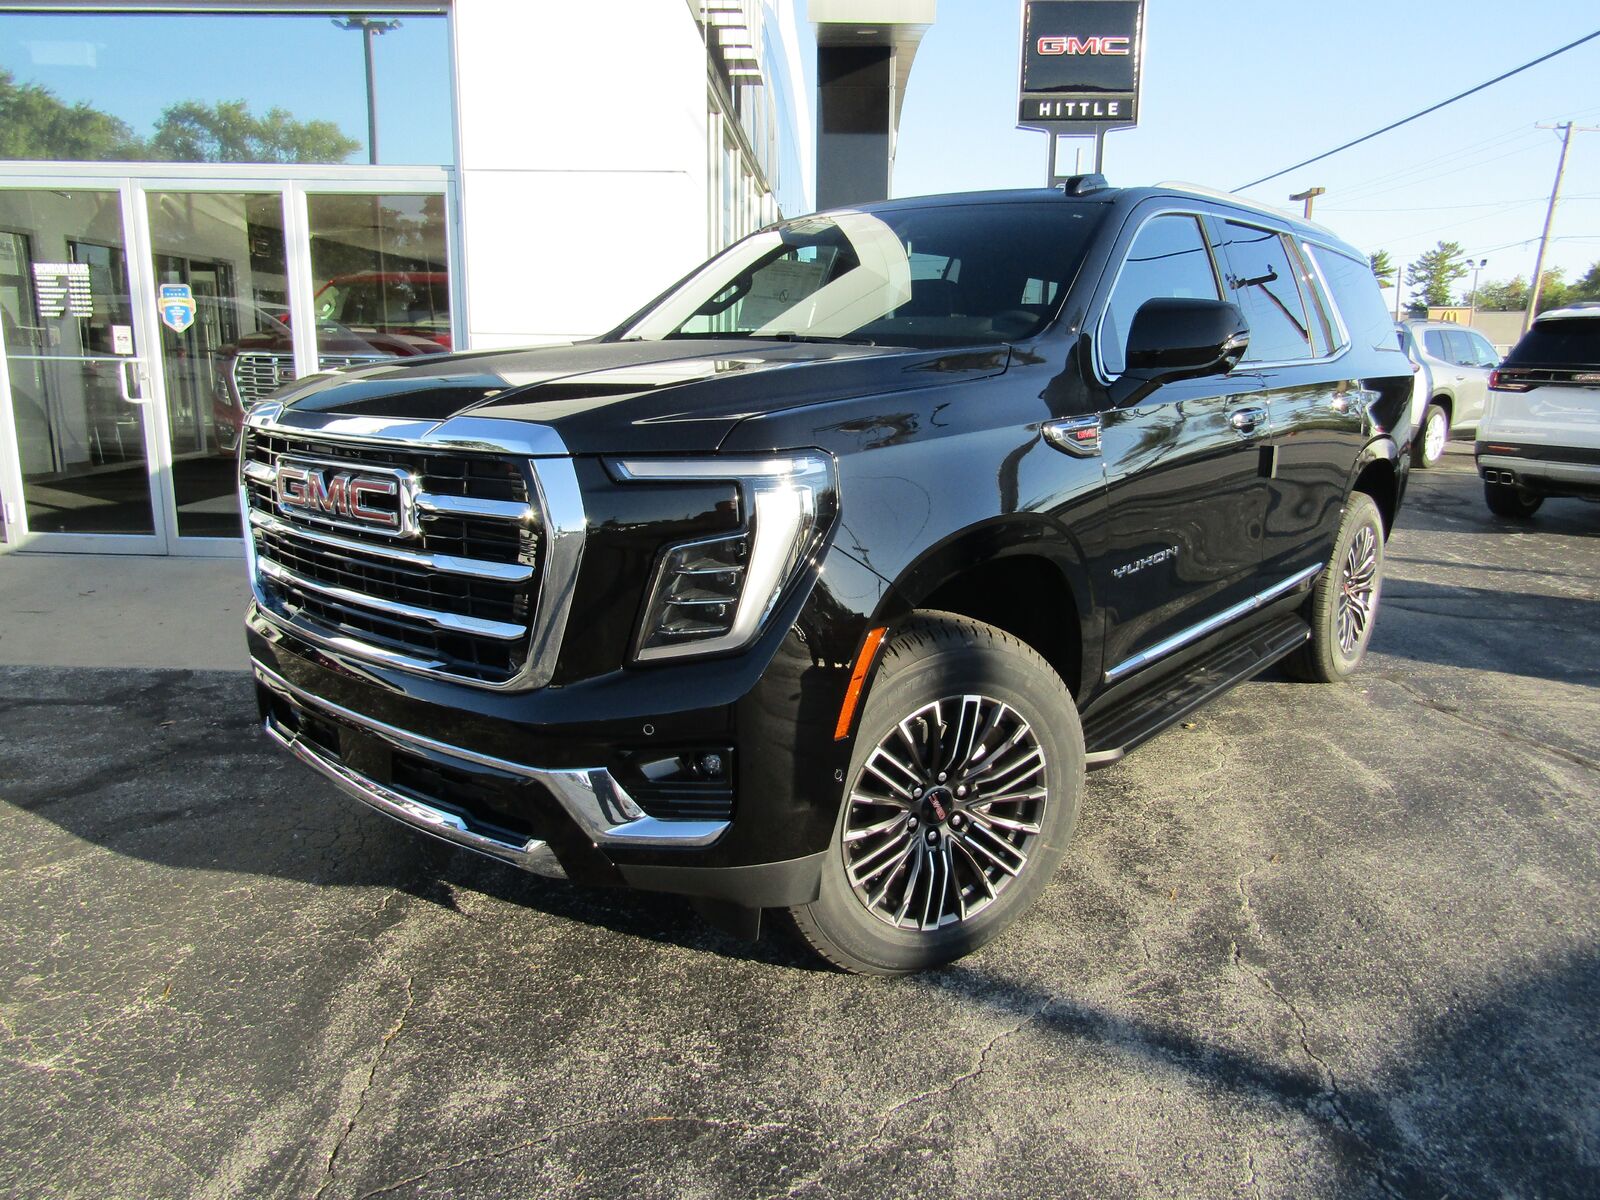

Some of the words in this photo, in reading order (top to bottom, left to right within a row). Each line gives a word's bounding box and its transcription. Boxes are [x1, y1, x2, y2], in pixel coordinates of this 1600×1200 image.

[1037, 36, 1130, 56] GMC
[1039, 102, 1119, 117] HITTLE
[1077, 428, 1096, 440] GMC
[276, 467, 398, 526] GMC
[1111, 545, 1178, 578] YUKON
